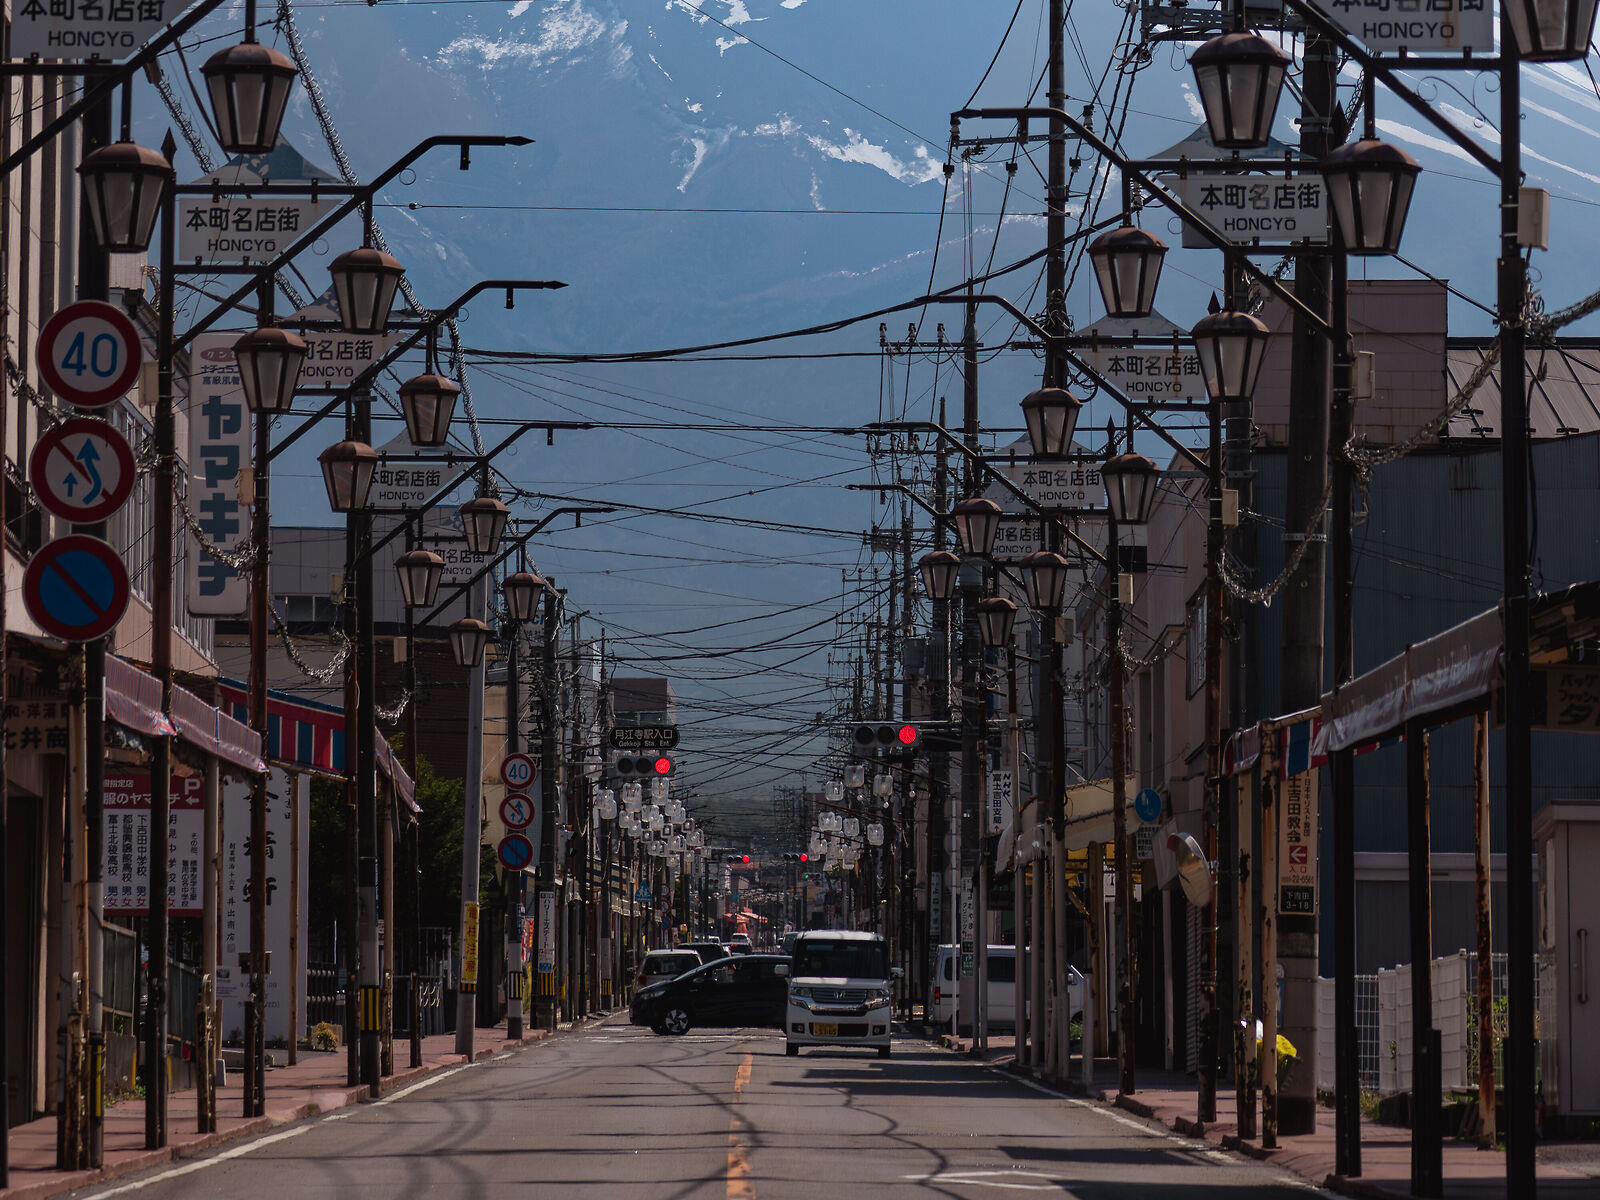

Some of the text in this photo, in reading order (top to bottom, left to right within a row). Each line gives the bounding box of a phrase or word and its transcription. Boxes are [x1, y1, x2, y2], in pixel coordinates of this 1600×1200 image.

[1200, 183, 1321, 210] 本町名店街
[186, 206, 300, 231] 本町名店街
[61, 331, 119, 378] 40
[1107, 355, 1201, 377] 本町名店街
[1023, 469, 1101, 487] 本町名店街
[198, 396, 242, 596] ヤマキチ
[615, 729, 673, 740] 月江寺駅入口
[508, 763, 528, 779] 40
[184, 778, 201, 796] P
[1003, 773, 1012, 797] NHK
[992, 773, 1001, 824] 富士吉田支局
[136, 814, 148, 877] 下吉田中学校
[1290, 865, 1307, 874] 入口
